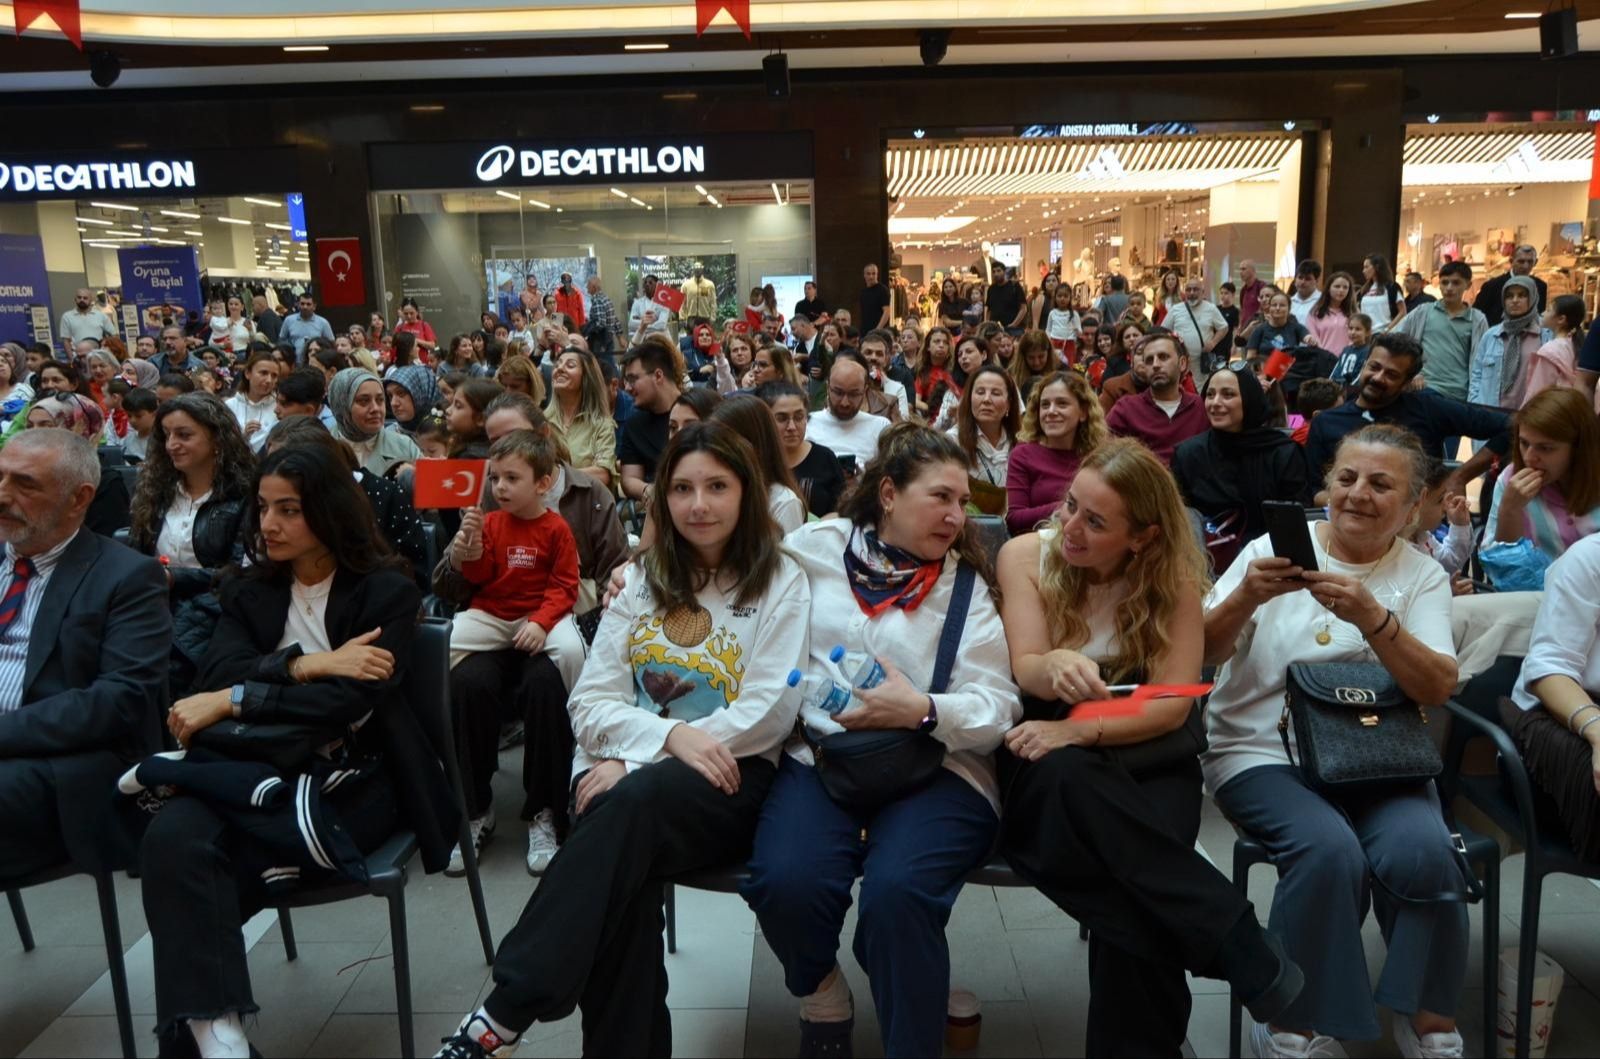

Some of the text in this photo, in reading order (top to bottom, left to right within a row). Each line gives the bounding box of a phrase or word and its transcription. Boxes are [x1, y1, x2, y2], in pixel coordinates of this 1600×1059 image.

[1060, 123, 1138, 137] ADISTAR CONTROL 5
[520, 146, 705, 176] DECATHLON
[12, 161, 196, 191] DECATHLON
[133, 266, 171, 279] Oyuna
[151, 276, 184, 290] Başla!
